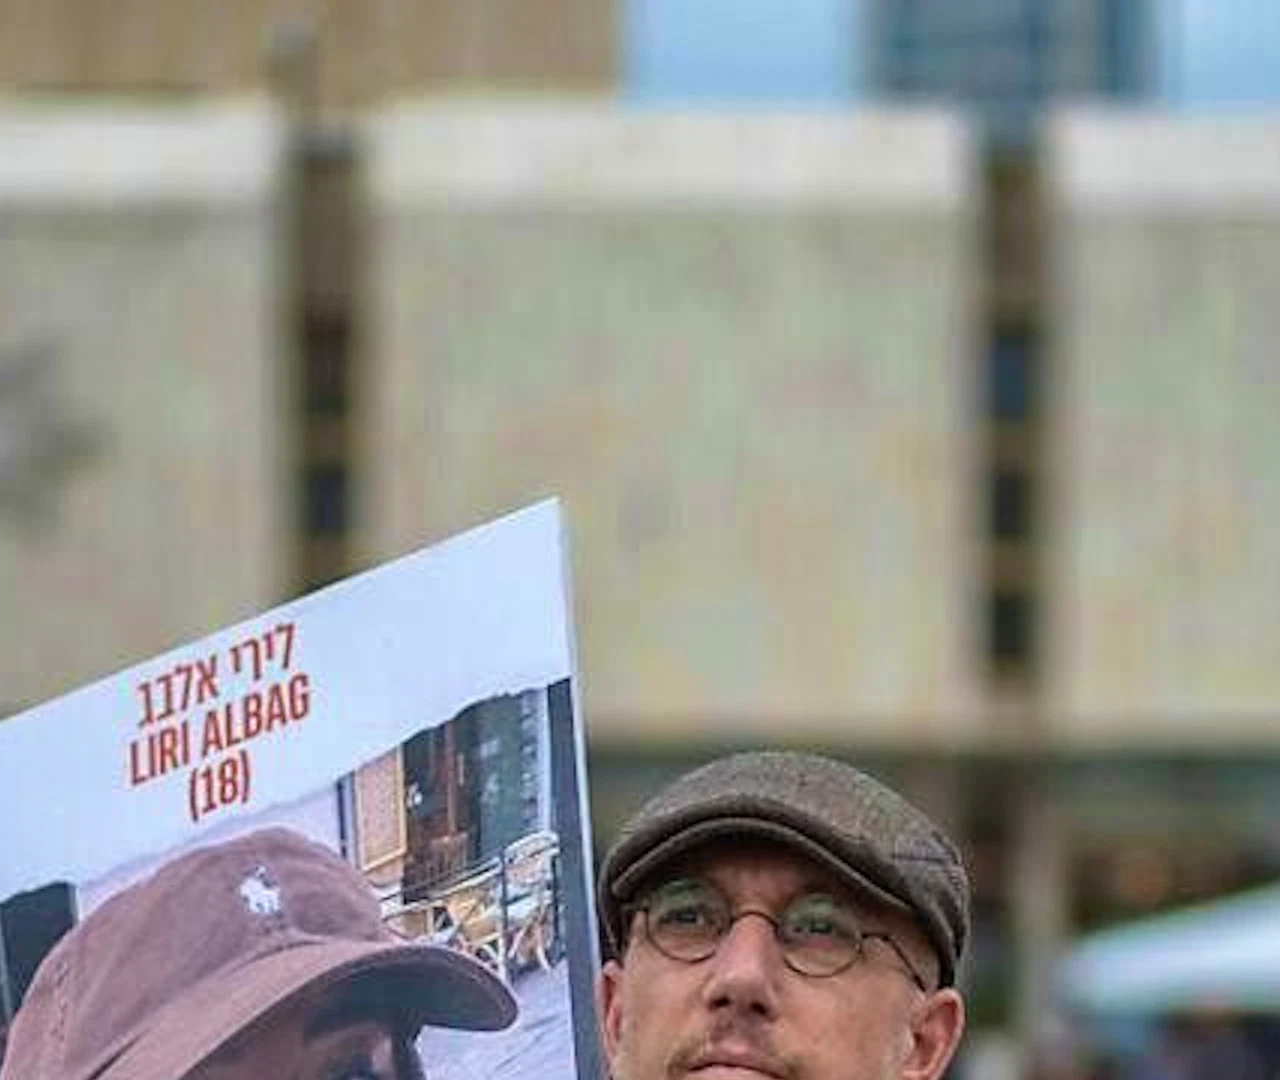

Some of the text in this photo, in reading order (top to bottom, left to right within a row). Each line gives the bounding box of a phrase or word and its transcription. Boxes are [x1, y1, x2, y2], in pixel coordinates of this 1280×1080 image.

[137, 623, 296, 729] לירי אלבג
[130, 672, 311, 787] LIRI ALBAG
[188, 749, 251, 822] (18)
